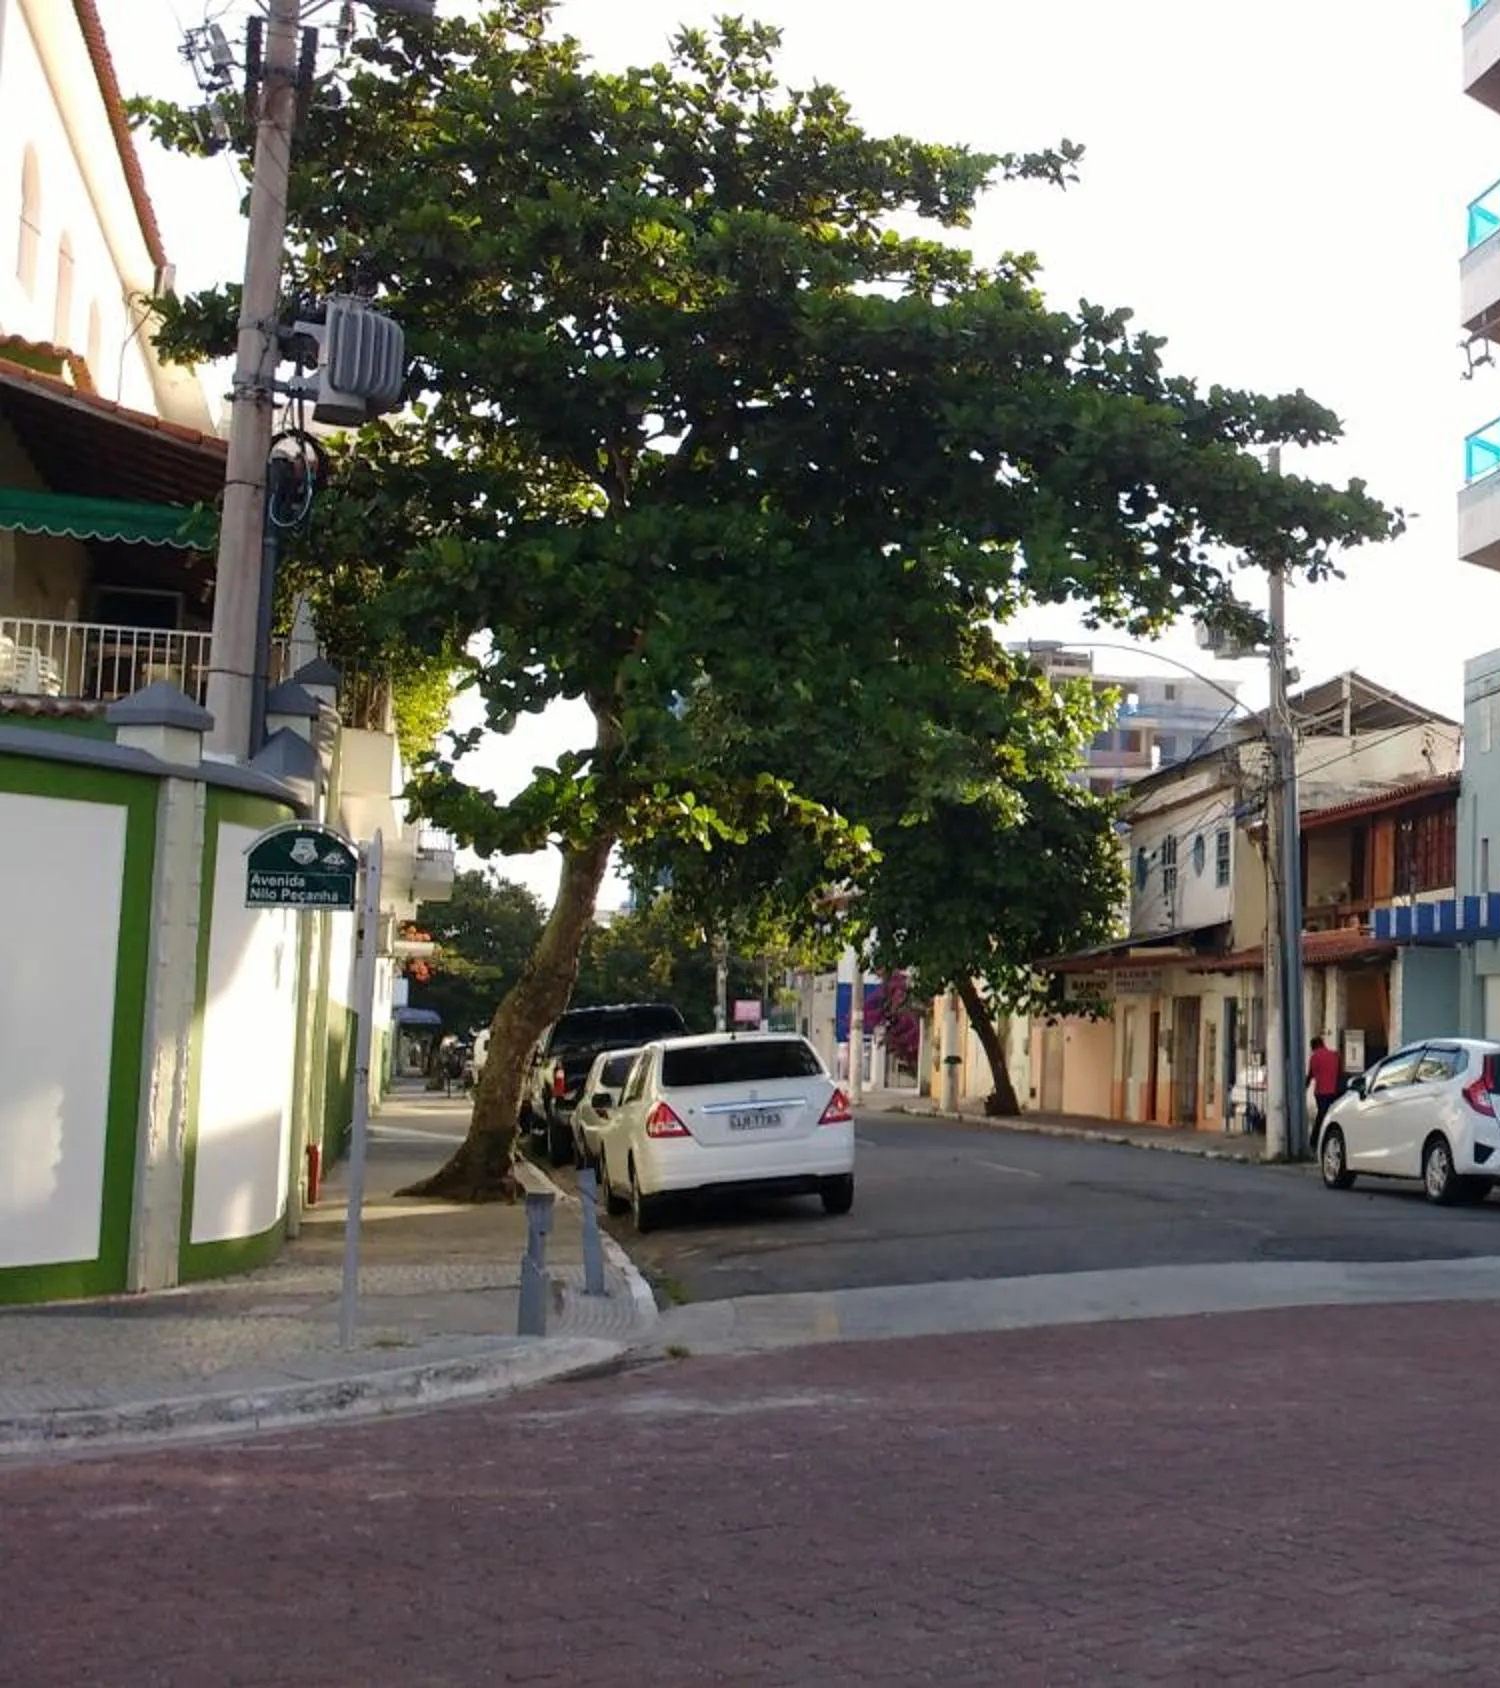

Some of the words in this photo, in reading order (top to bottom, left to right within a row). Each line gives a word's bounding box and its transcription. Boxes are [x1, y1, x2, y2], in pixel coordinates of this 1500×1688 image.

[251, 873, 306, 887] Avenida
[249, 887, 278, 900] Nilo
[281, 888, 339, 904] Peçanha
